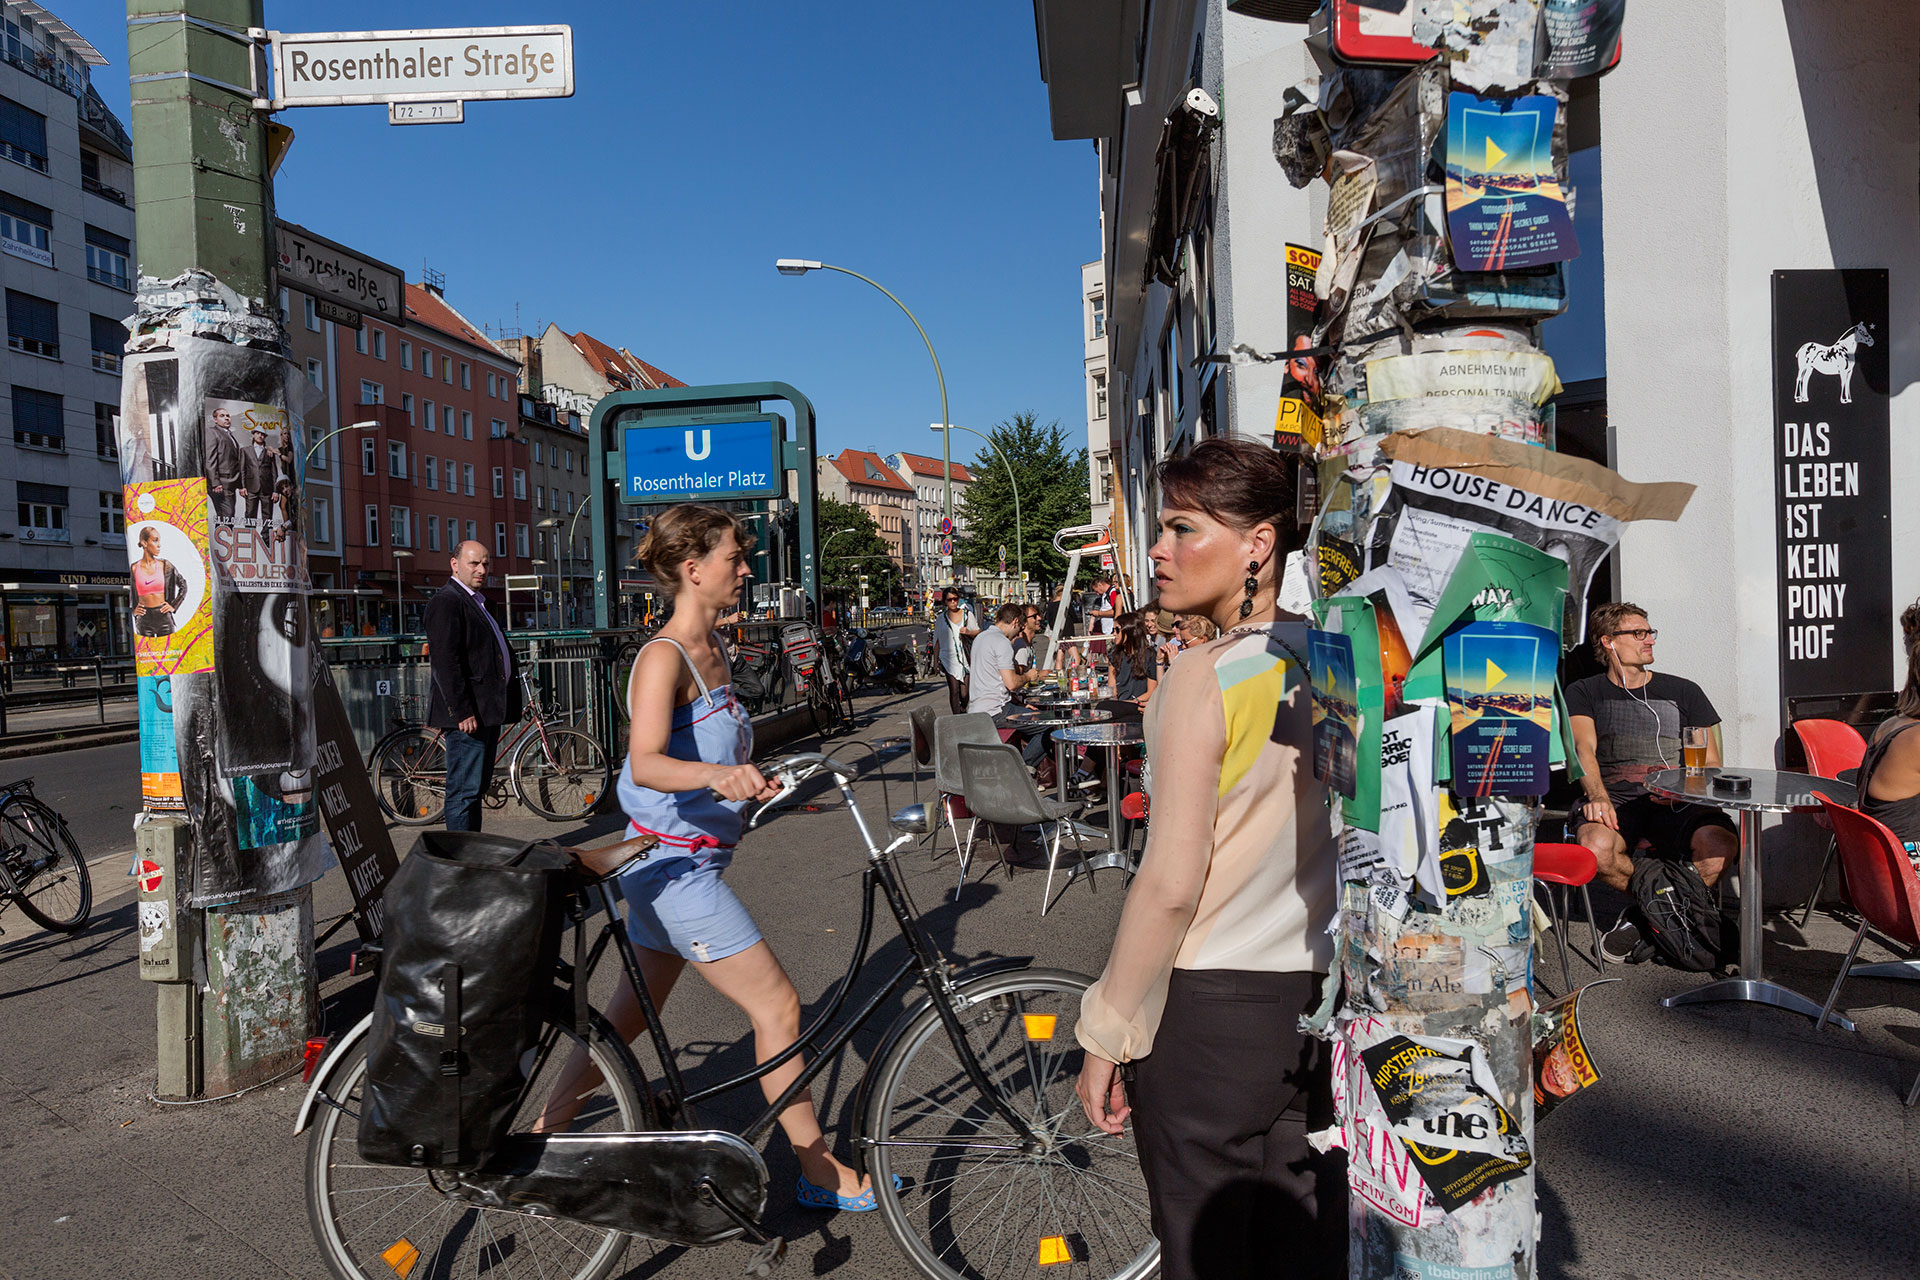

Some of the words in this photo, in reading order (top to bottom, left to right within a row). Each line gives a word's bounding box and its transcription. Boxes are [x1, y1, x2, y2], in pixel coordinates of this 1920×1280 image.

[291, 47, 453, 82] Rosenthaler
[464, 43, 555, 83] Straße
[401, 107, 413, 117] 72
[432, 106, 443, 117] 71
[1289, 274, 1312, 292] SAT.
[322, 304, 337, 316] 118
[346, 313, 357, 323] 90
[1440, 364, 1507, 377] ABNEHMEN
[1509, 366, 1527, 378] MIT
[685, 429, 711, 461] U
[1784, 422, 1831, 457] DAS
[633, 472, 724, 492] Rosenthaler
[728, 469, 766, 487] Platz
[1411, 461, 1501, 503] HOUSE
[1505, 489, 1603, 530] DANCE
[1784, 462, 1859, 498] LEBEN
[1786, 503, 1823, 539] IST
[59, 574, 87, 584] KIND
[1786, 543, 1840, 580] KEIN
[1787, 583, 1847, 620] PONY
[1789, 624, 1835, 661] HOF
[317, 739, 344, 779] UCKER
[322, 782, 351, 819] MEHL
[337, 820, 363, 858] SALZ
[351, 853, 385, 900] KAFFEE
